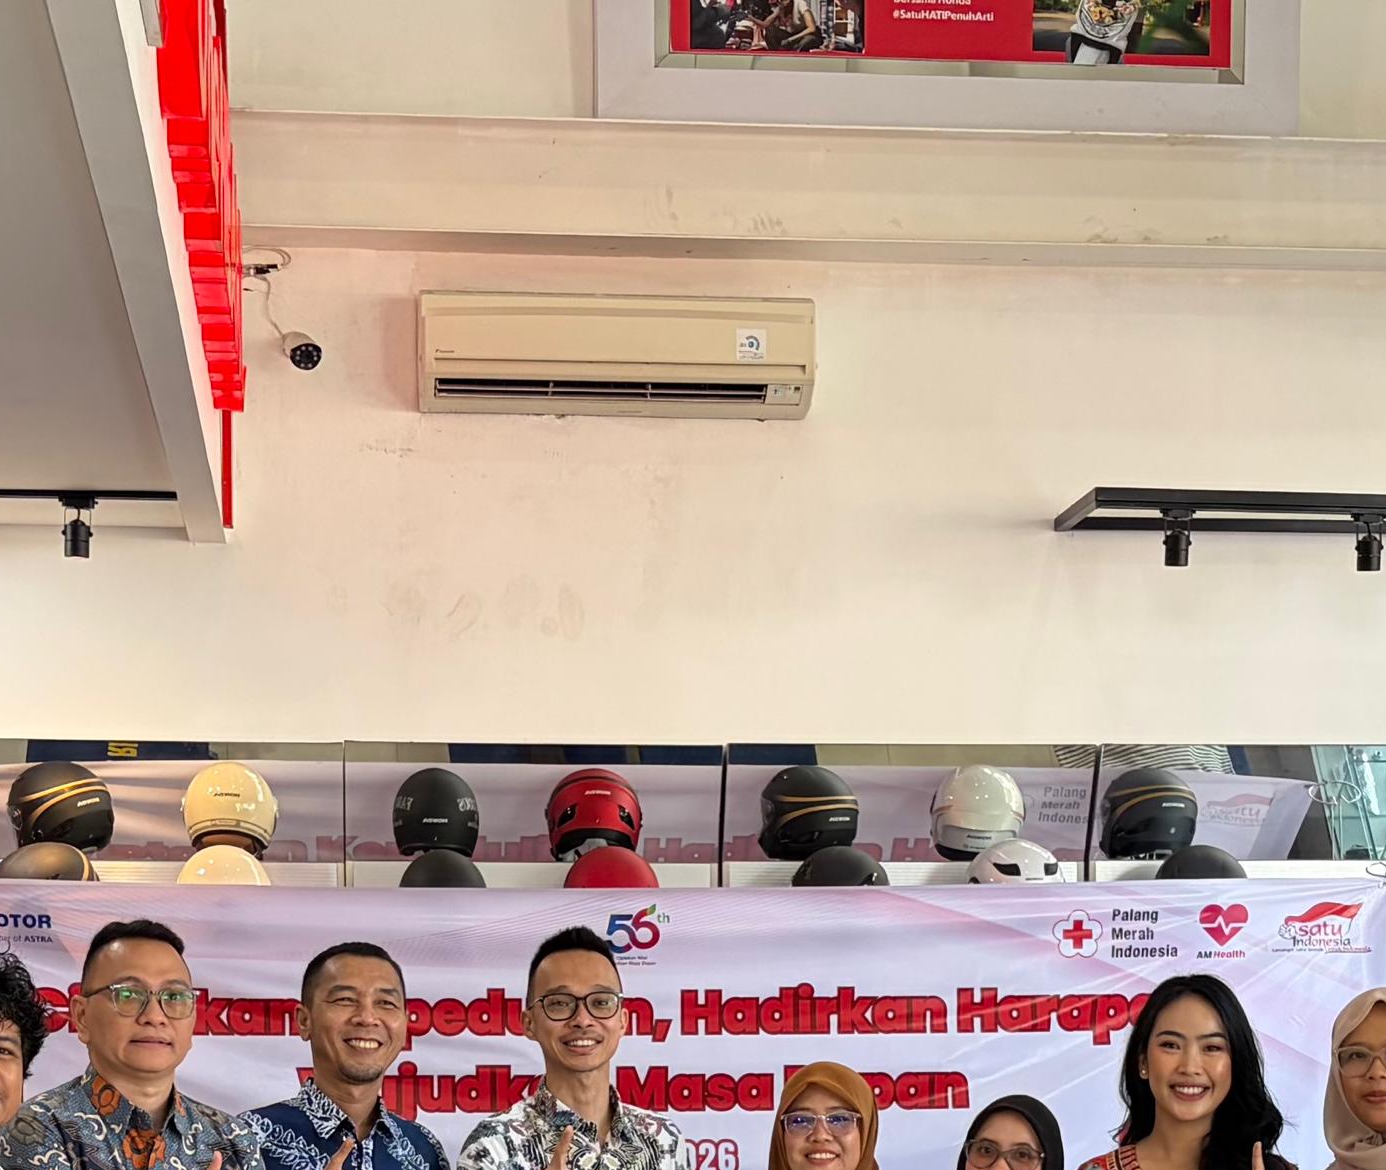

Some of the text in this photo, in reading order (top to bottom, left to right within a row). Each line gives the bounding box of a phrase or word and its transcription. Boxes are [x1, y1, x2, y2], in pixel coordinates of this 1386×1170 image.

[893, 9, 994, 21] #SatuHATIPenuhArti
[1038, 811, 1089, 826] Indones
[1112, 908, 1159, 924] Palang
[1112, 927, 1154, 941] Merah
[1299, 921, 1342, 936] satu
[1292, 936, 1351, 947] Indonesia
[1111, 944, 1178, 959] Indonesia
[680, 982, 947, 1035] Hadirkan
[957, 987, 1153, 1045] Harap
[616, 1065, 774, 1112] Masa
